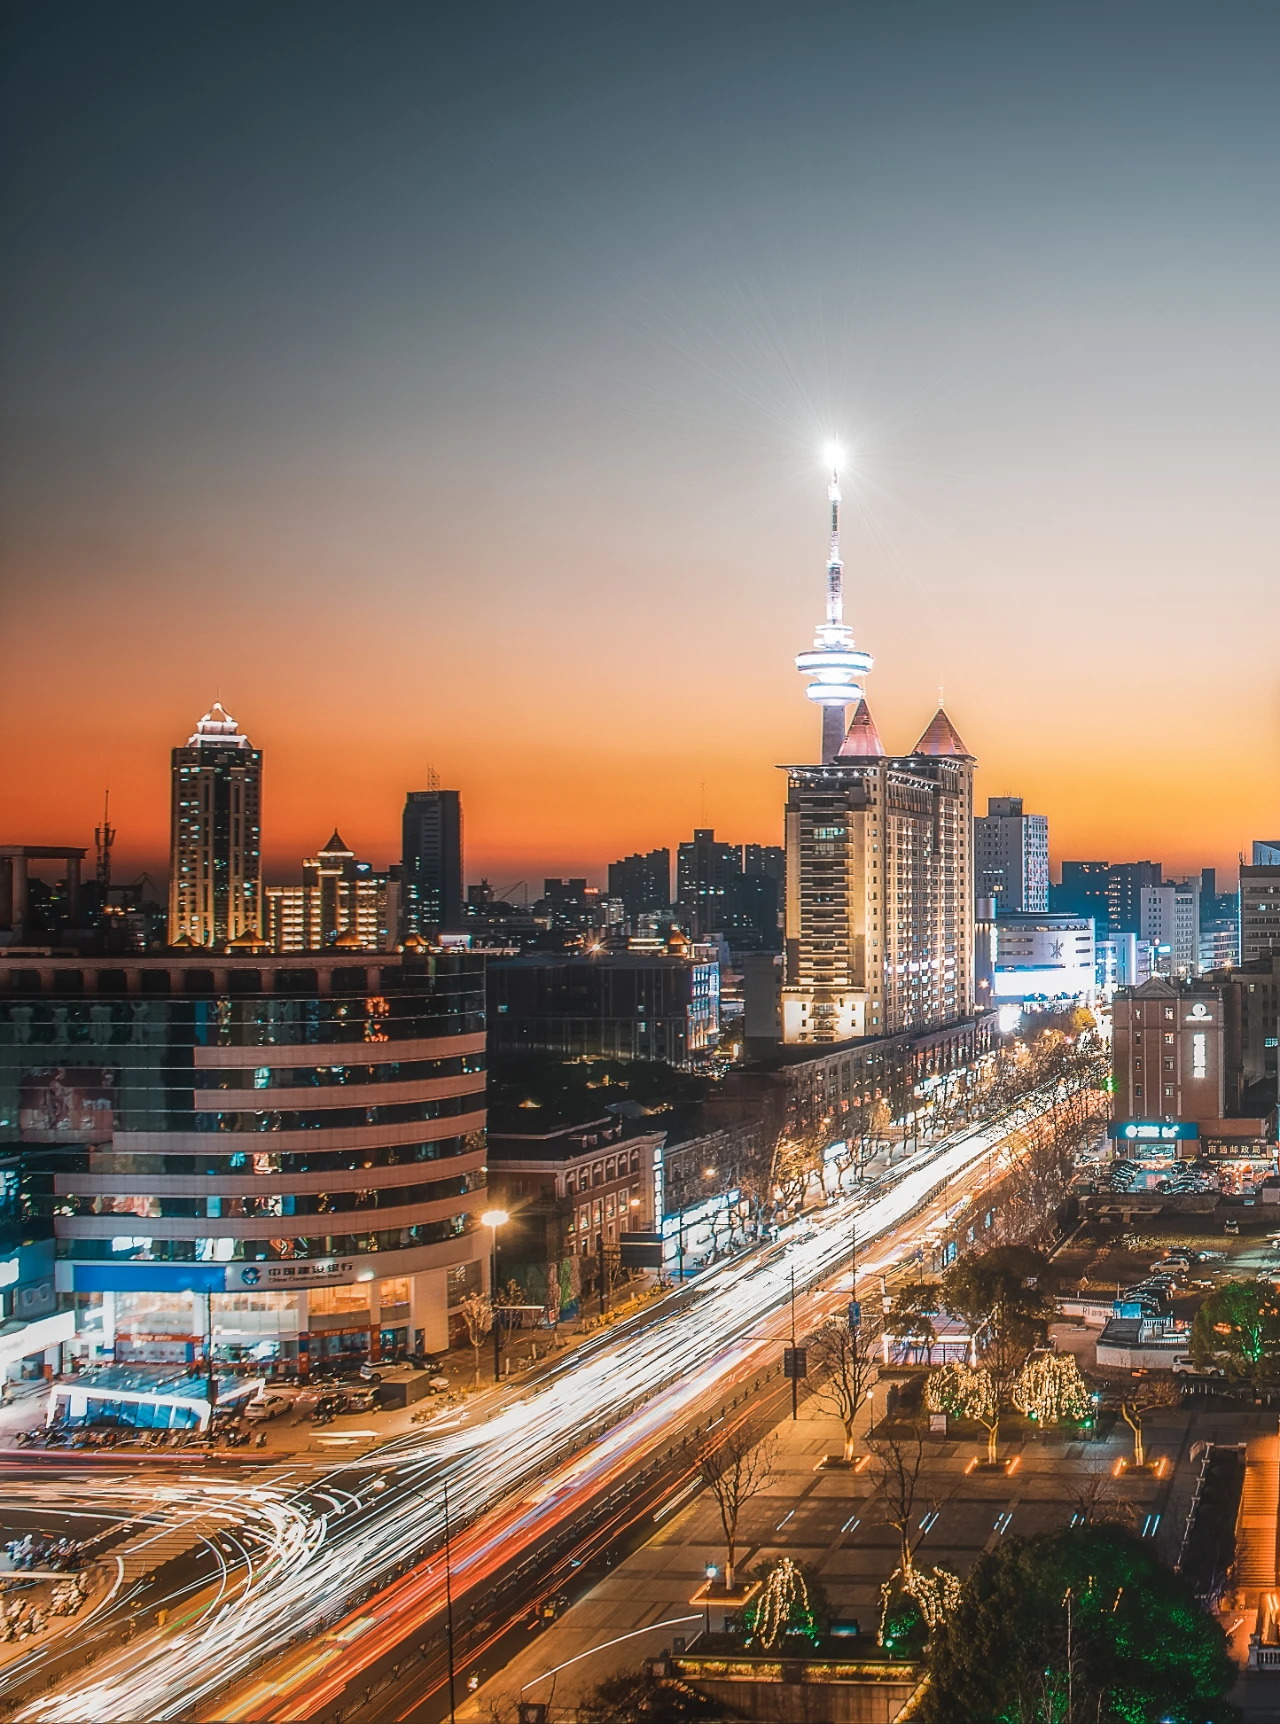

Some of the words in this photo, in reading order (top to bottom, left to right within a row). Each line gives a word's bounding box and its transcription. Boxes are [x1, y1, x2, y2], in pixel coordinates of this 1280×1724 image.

[1208, 1145, 1260, 1154] 南通邮政局
[268, 1262, 354, 1276] 中国建设银行
